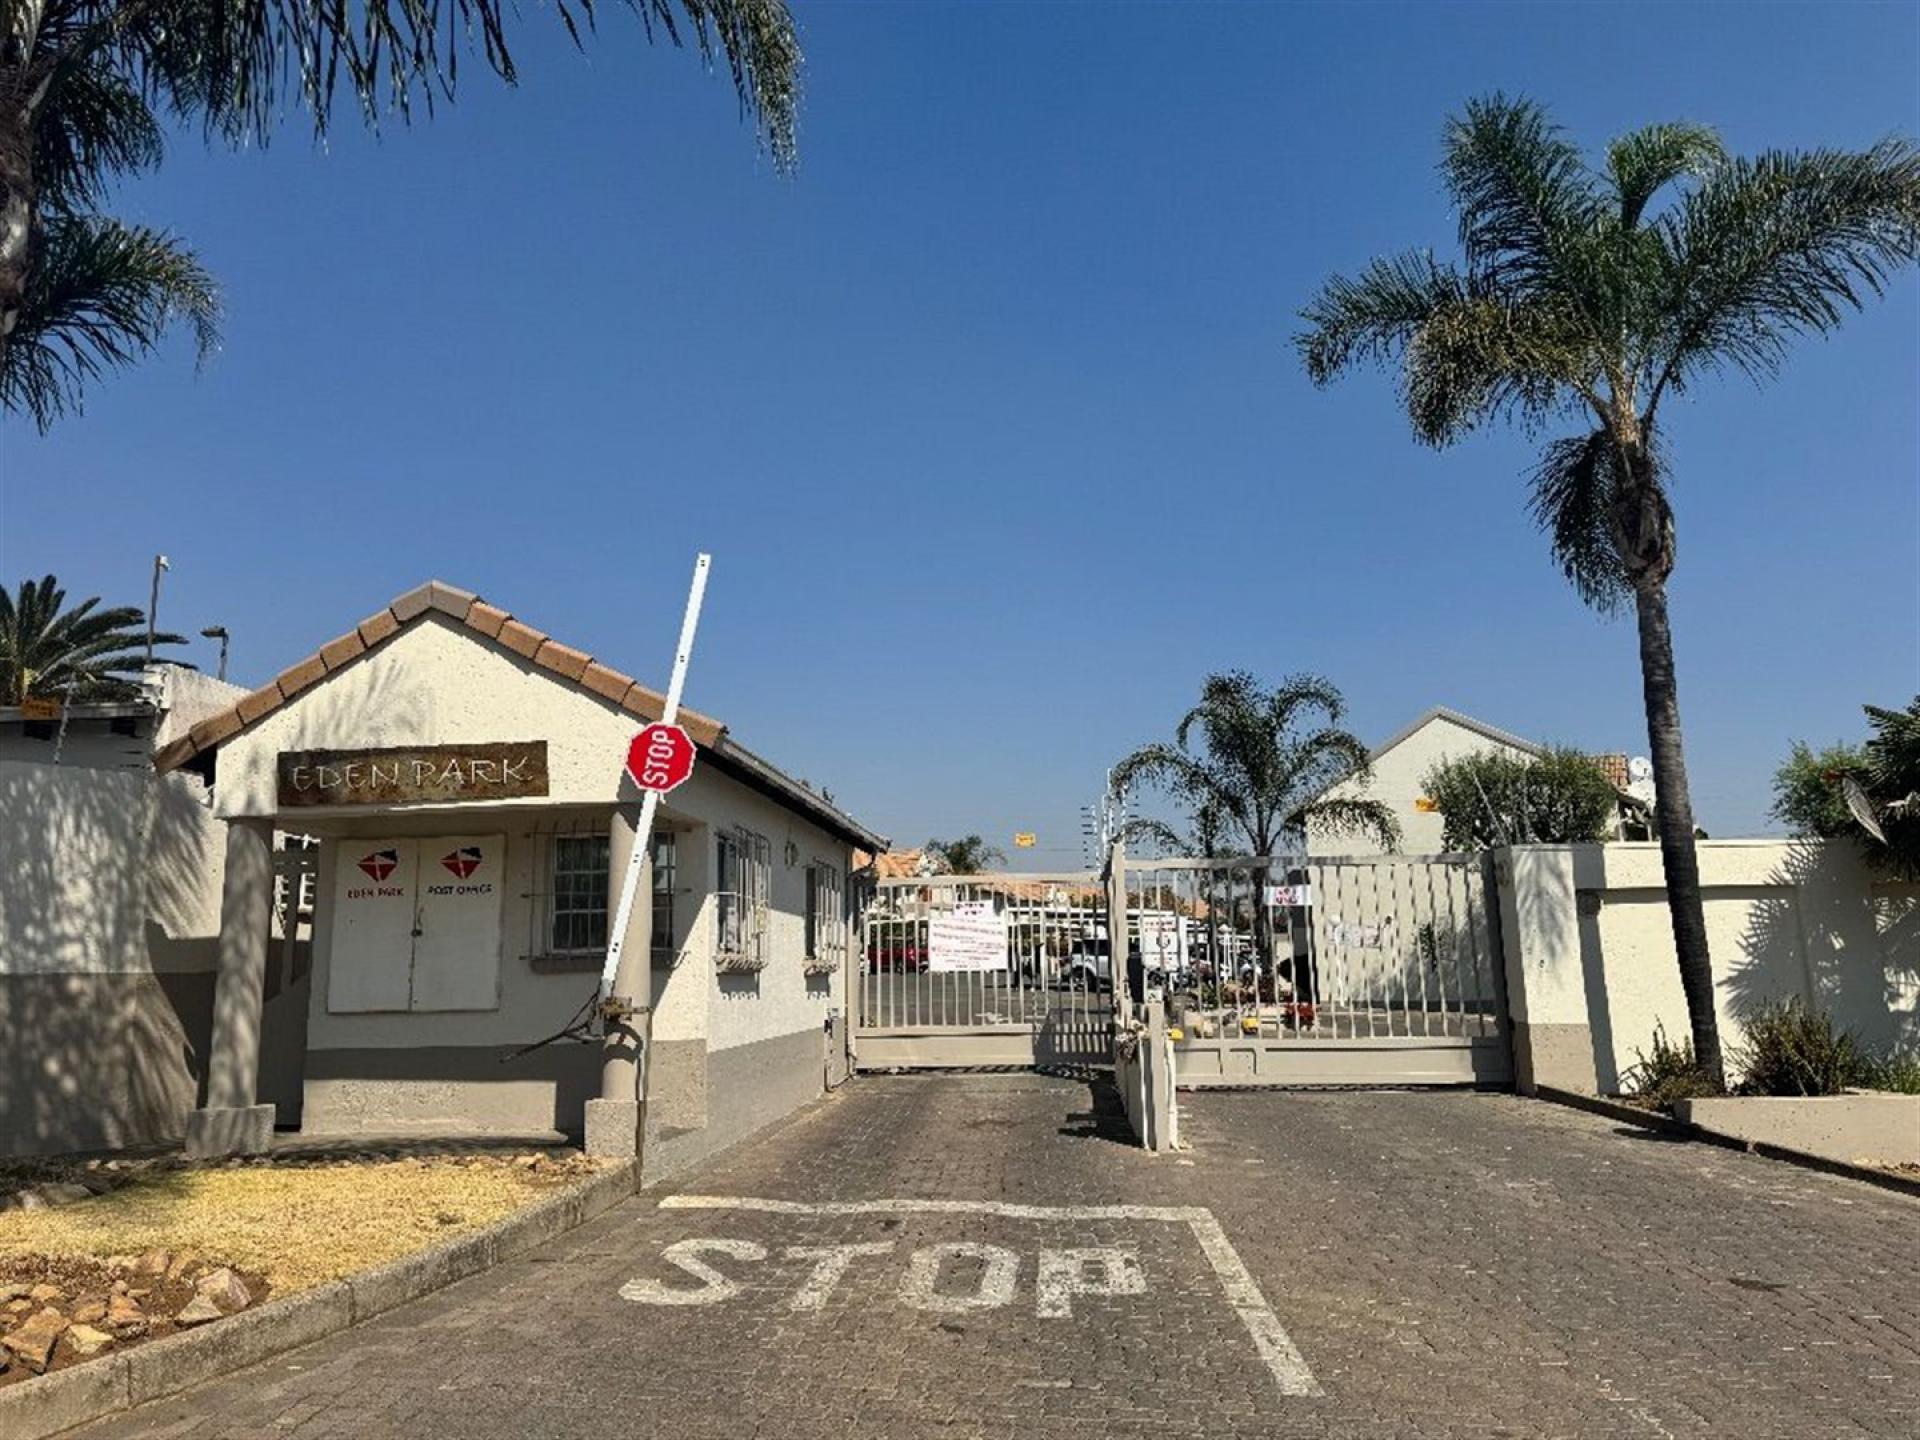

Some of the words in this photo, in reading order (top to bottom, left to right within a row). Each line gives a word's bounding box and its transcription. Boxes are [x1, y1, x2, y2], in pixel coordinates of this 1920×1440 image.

[292, 763, 399, 791] EDEN
[411, 756, 534, 787] PARK
[642, 730, 676, 786] STOP
[618, 1239, 1148, 1318] STOP
